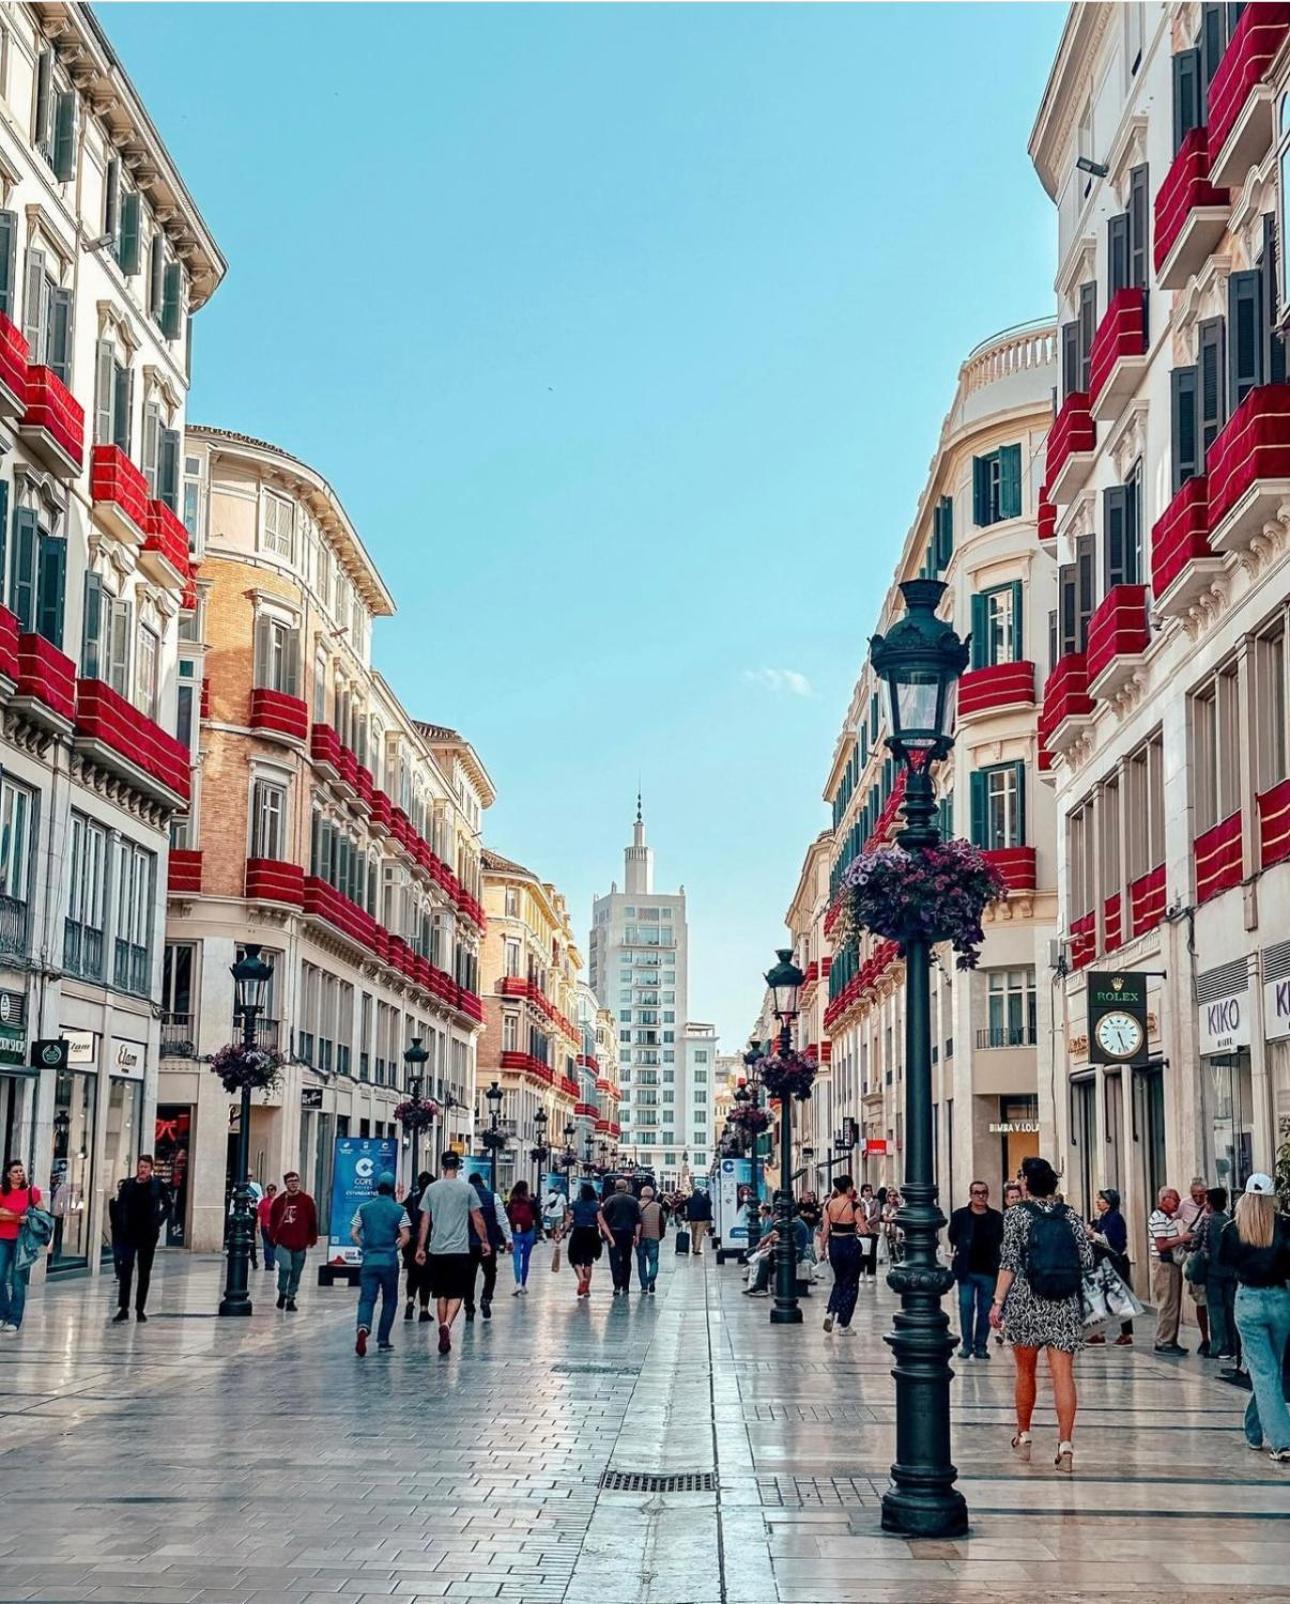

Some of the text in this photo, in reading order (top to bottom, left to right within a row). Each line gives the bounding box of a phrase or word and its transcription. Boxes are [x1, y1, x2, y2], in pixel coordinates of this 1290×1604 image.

[1096, 992, 1139, 1001] ROLEX
[1208, 999, 1240, 1036] KIKO
[1015, 1124, 1020, 1132] Y
[1021, 1124, 1040, 1132] LOLA
